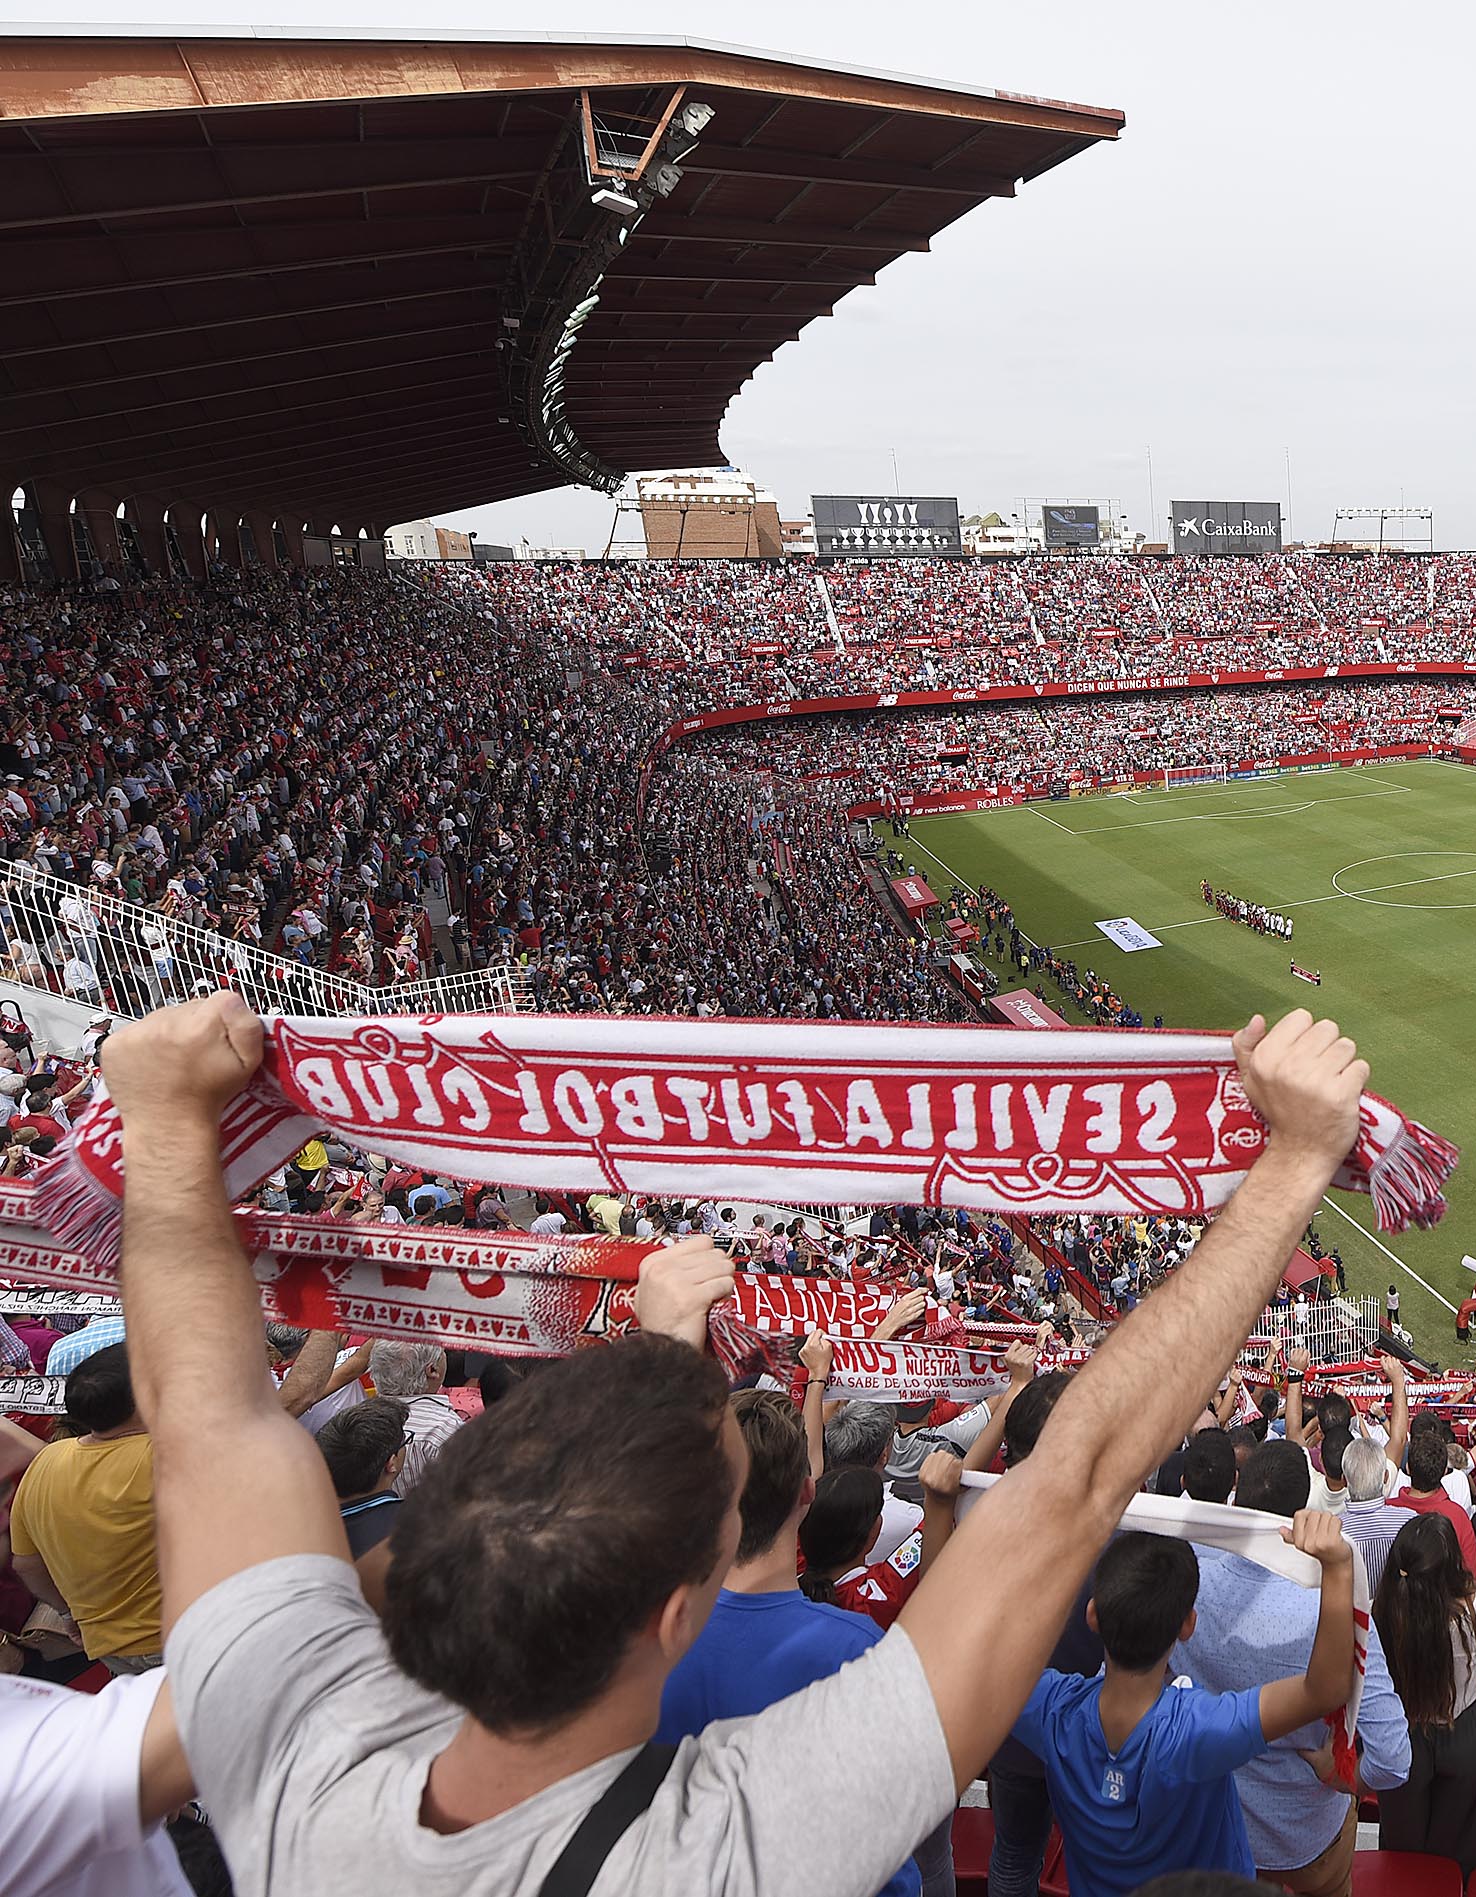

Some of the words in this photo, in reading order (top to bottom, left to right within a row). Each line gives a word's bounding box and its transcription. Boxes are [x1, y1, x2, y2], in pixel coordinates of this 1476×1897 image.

[1201, 518, 1277, 536] CaixaBank
[846, 557, 869, 565] Giralda
[1067, 681, 1095, 693] DICEN
[1097, 680, 1116, 692] QUE
[1116, 678, 1149, 691] NUNCA
[1149, 677, 1162, 688] SE
[1163, 676, 1190, 687] RINDE
[953, 690, 980, 701] Coca-Cola
[766, 703, 793, 716] Coca-Cola
[1364, 758, 1379, 766] new
[1379, 755, 1407, 764] balance
[1259, 768, 1278, 776] bet365
[1280, 766, 1299, 774] bet365
[938, 804, 967, 812] balance
[976, 796, 1016, 810] ROBLES
[905, 1359, 962, 1377] NUESTRA
[847, 1375, 880, 1389] SABE
[883, 1376, 901, 1390] DE
[903, 1377, 922, 1389] LO
[923, 1378, 945, 1391] QUE
[952, 1376, 996, 1389] SOMOS
[898, 1389, 907, 1400] 14
[909, 1389, 932, 1400] MAYO
[1106, 1770, 1125, 1787] AR
[1109, 1785, 1121, 1801] 2
